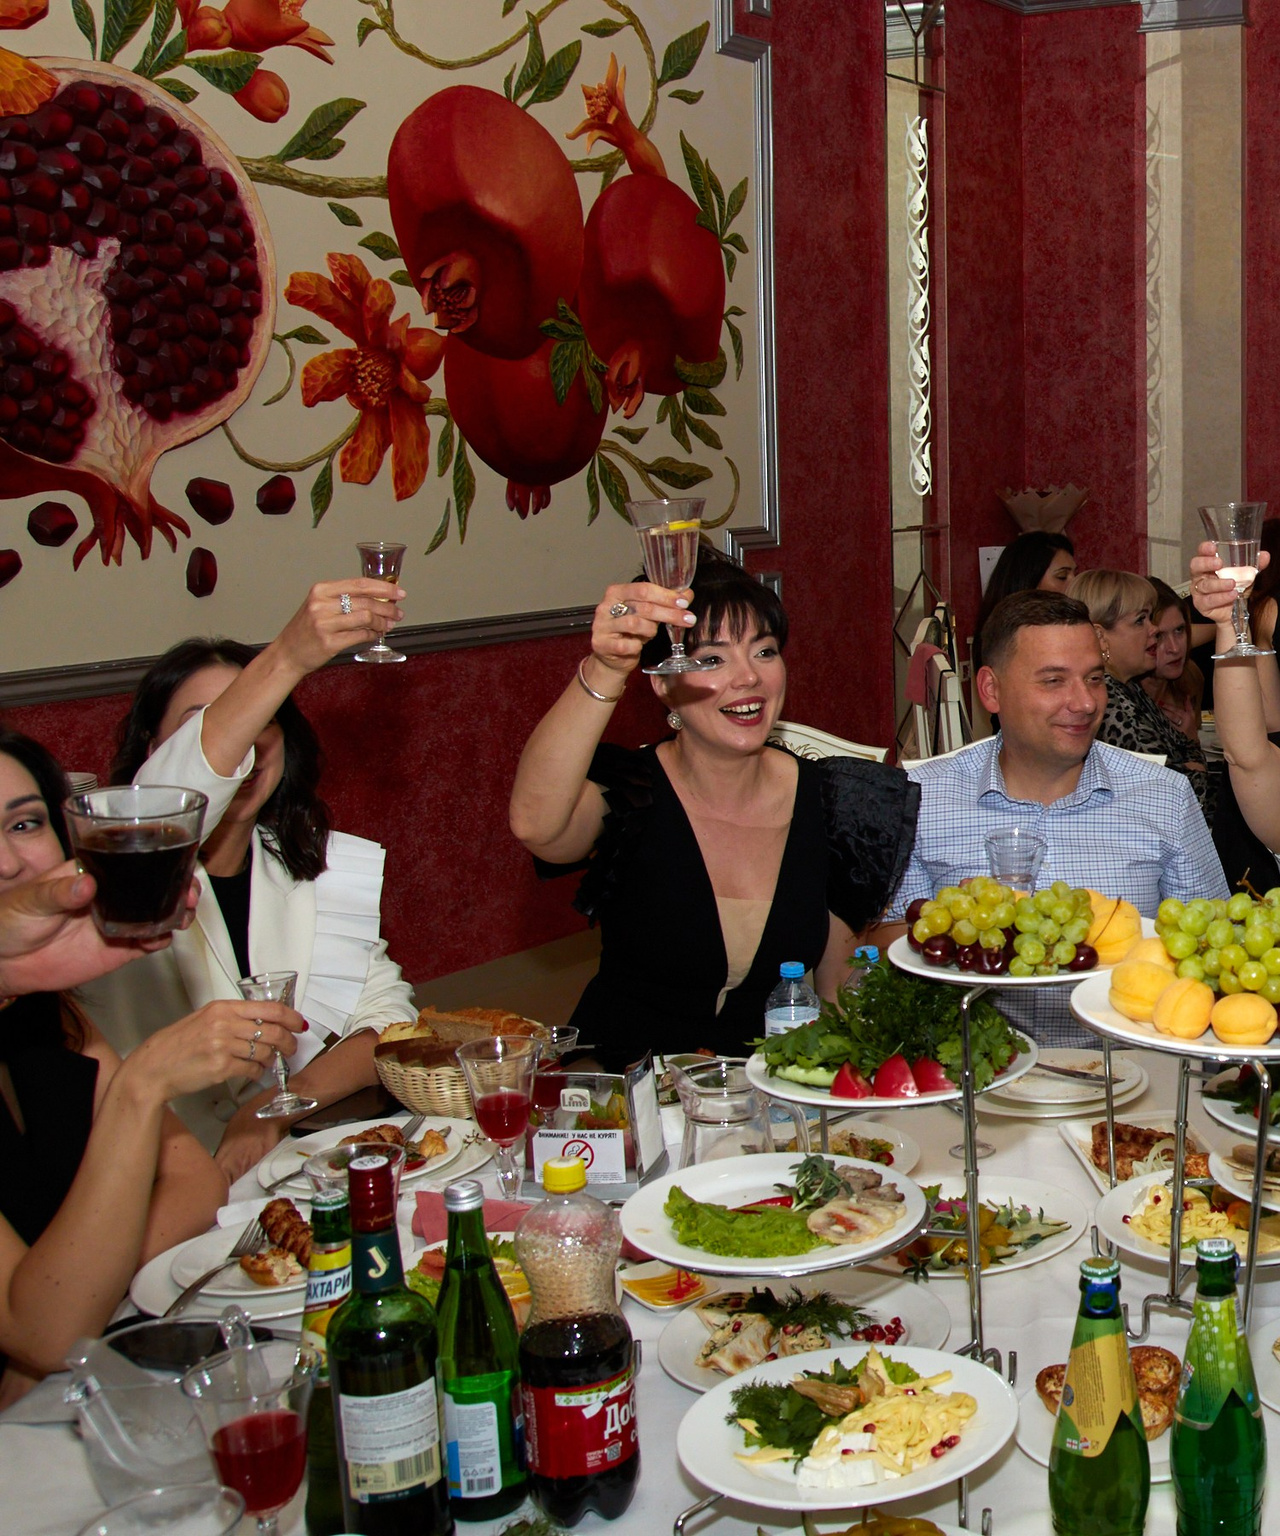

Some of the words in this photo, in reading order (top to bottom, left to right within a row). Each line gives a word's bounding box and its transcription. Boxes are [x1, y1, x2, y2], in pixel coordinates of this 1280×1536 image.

[561, 1093, 589, 1108] Lime
[538, 1131, 569, 1139] ВНИМАНИЕ!
[368, 1245, 390, 1279] J
[307, 1272, 351, 1299] АХТАРИ
[604, 1388, 637, 1441] Доб
